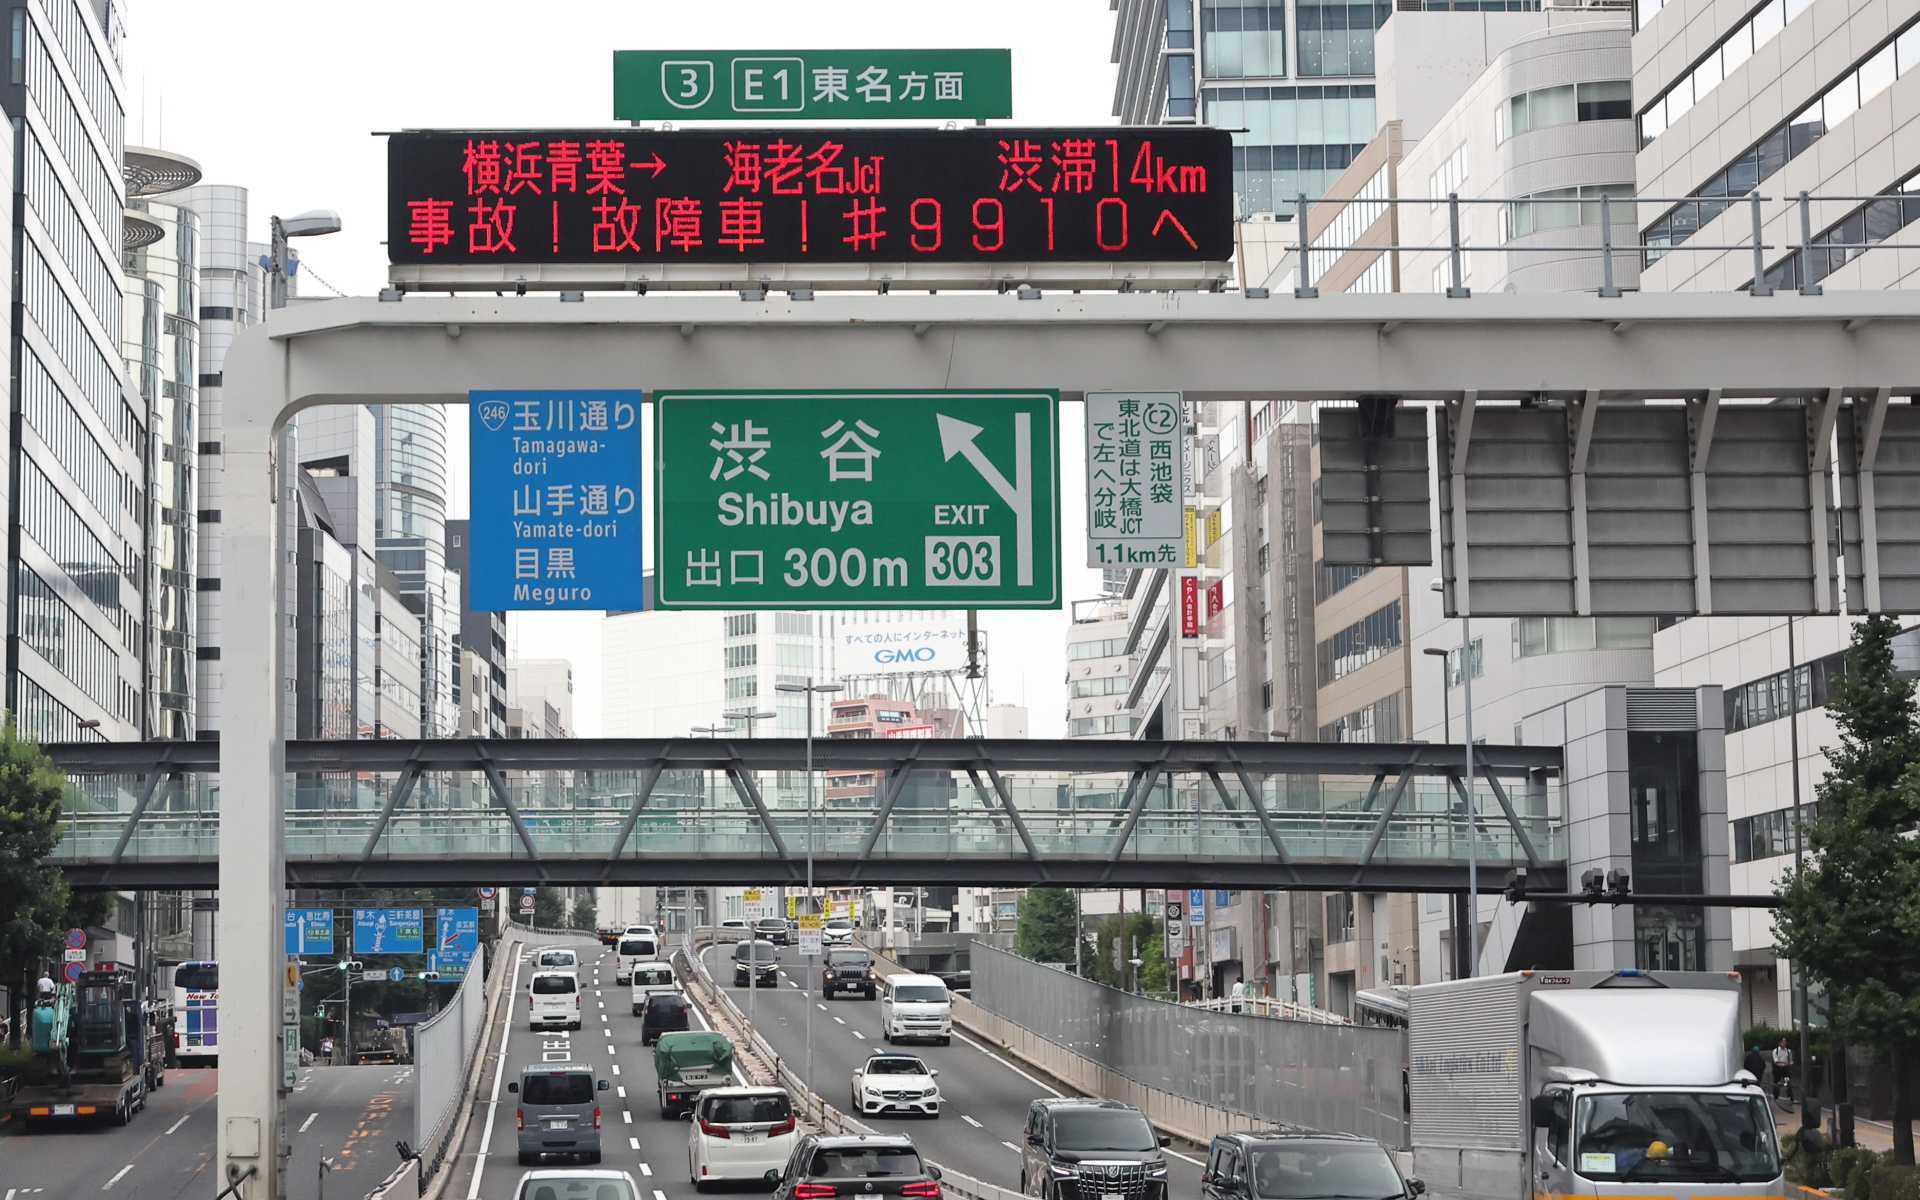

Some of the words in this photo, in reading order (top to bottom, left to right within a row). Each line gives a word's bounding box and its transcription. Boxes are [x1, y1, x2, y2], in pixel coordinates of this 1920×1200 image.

[679, 68, 698, 98] 3
[744, 68, 789, 100] E1
[812, 65, 964, 103] 東名方面
[462, 139, 625, 195] 横浜青葉
[723, 138, 885, 195] 海老名JCT
[997, 138, 1207, 194] 渋滞14km
[483, 406, 506, 420] 246
[512, 400, 635, 432] 玉川通り
[512, 437, 606, 457] Tamagawa-
[709, 419, 882, 482] 渋谷
[512, 457, 548, 475] dori
[1093, 422, 1118, 530] で左へ分岐
[1117, 399, 1145, 535] 東北道は大橋JCT
[1149, 440, 1173, 504] 西池袋
[512, 483, 635, 516] 山手通り
[717, 491, 874, 533] Shibuya
[512, 519, 618, 538] Yamate-dori
[933, 504, 990, 526] EXIT
[514, 548, 576, 580] 目黒
[685, 547, 765, 588] 出口
[782, 547, 909, 588] 300m
[931, 540, 995, 582] 303
[1095, 543, 1177, 565] 1.1km先
[512, 584, 592, 606] Meguro
[845, 628, 966, 645] すべての人にインターネット
[874, 647, 936, 664] GMO
[523, 897, 532, 905] 40
[306, 911, 330, 921] 恵比寿
[356, 910, 375, 919] 厚木
[388, 910, 421, 920] 三軒茶屋
[543, 1040, 571, 1062] 出口
